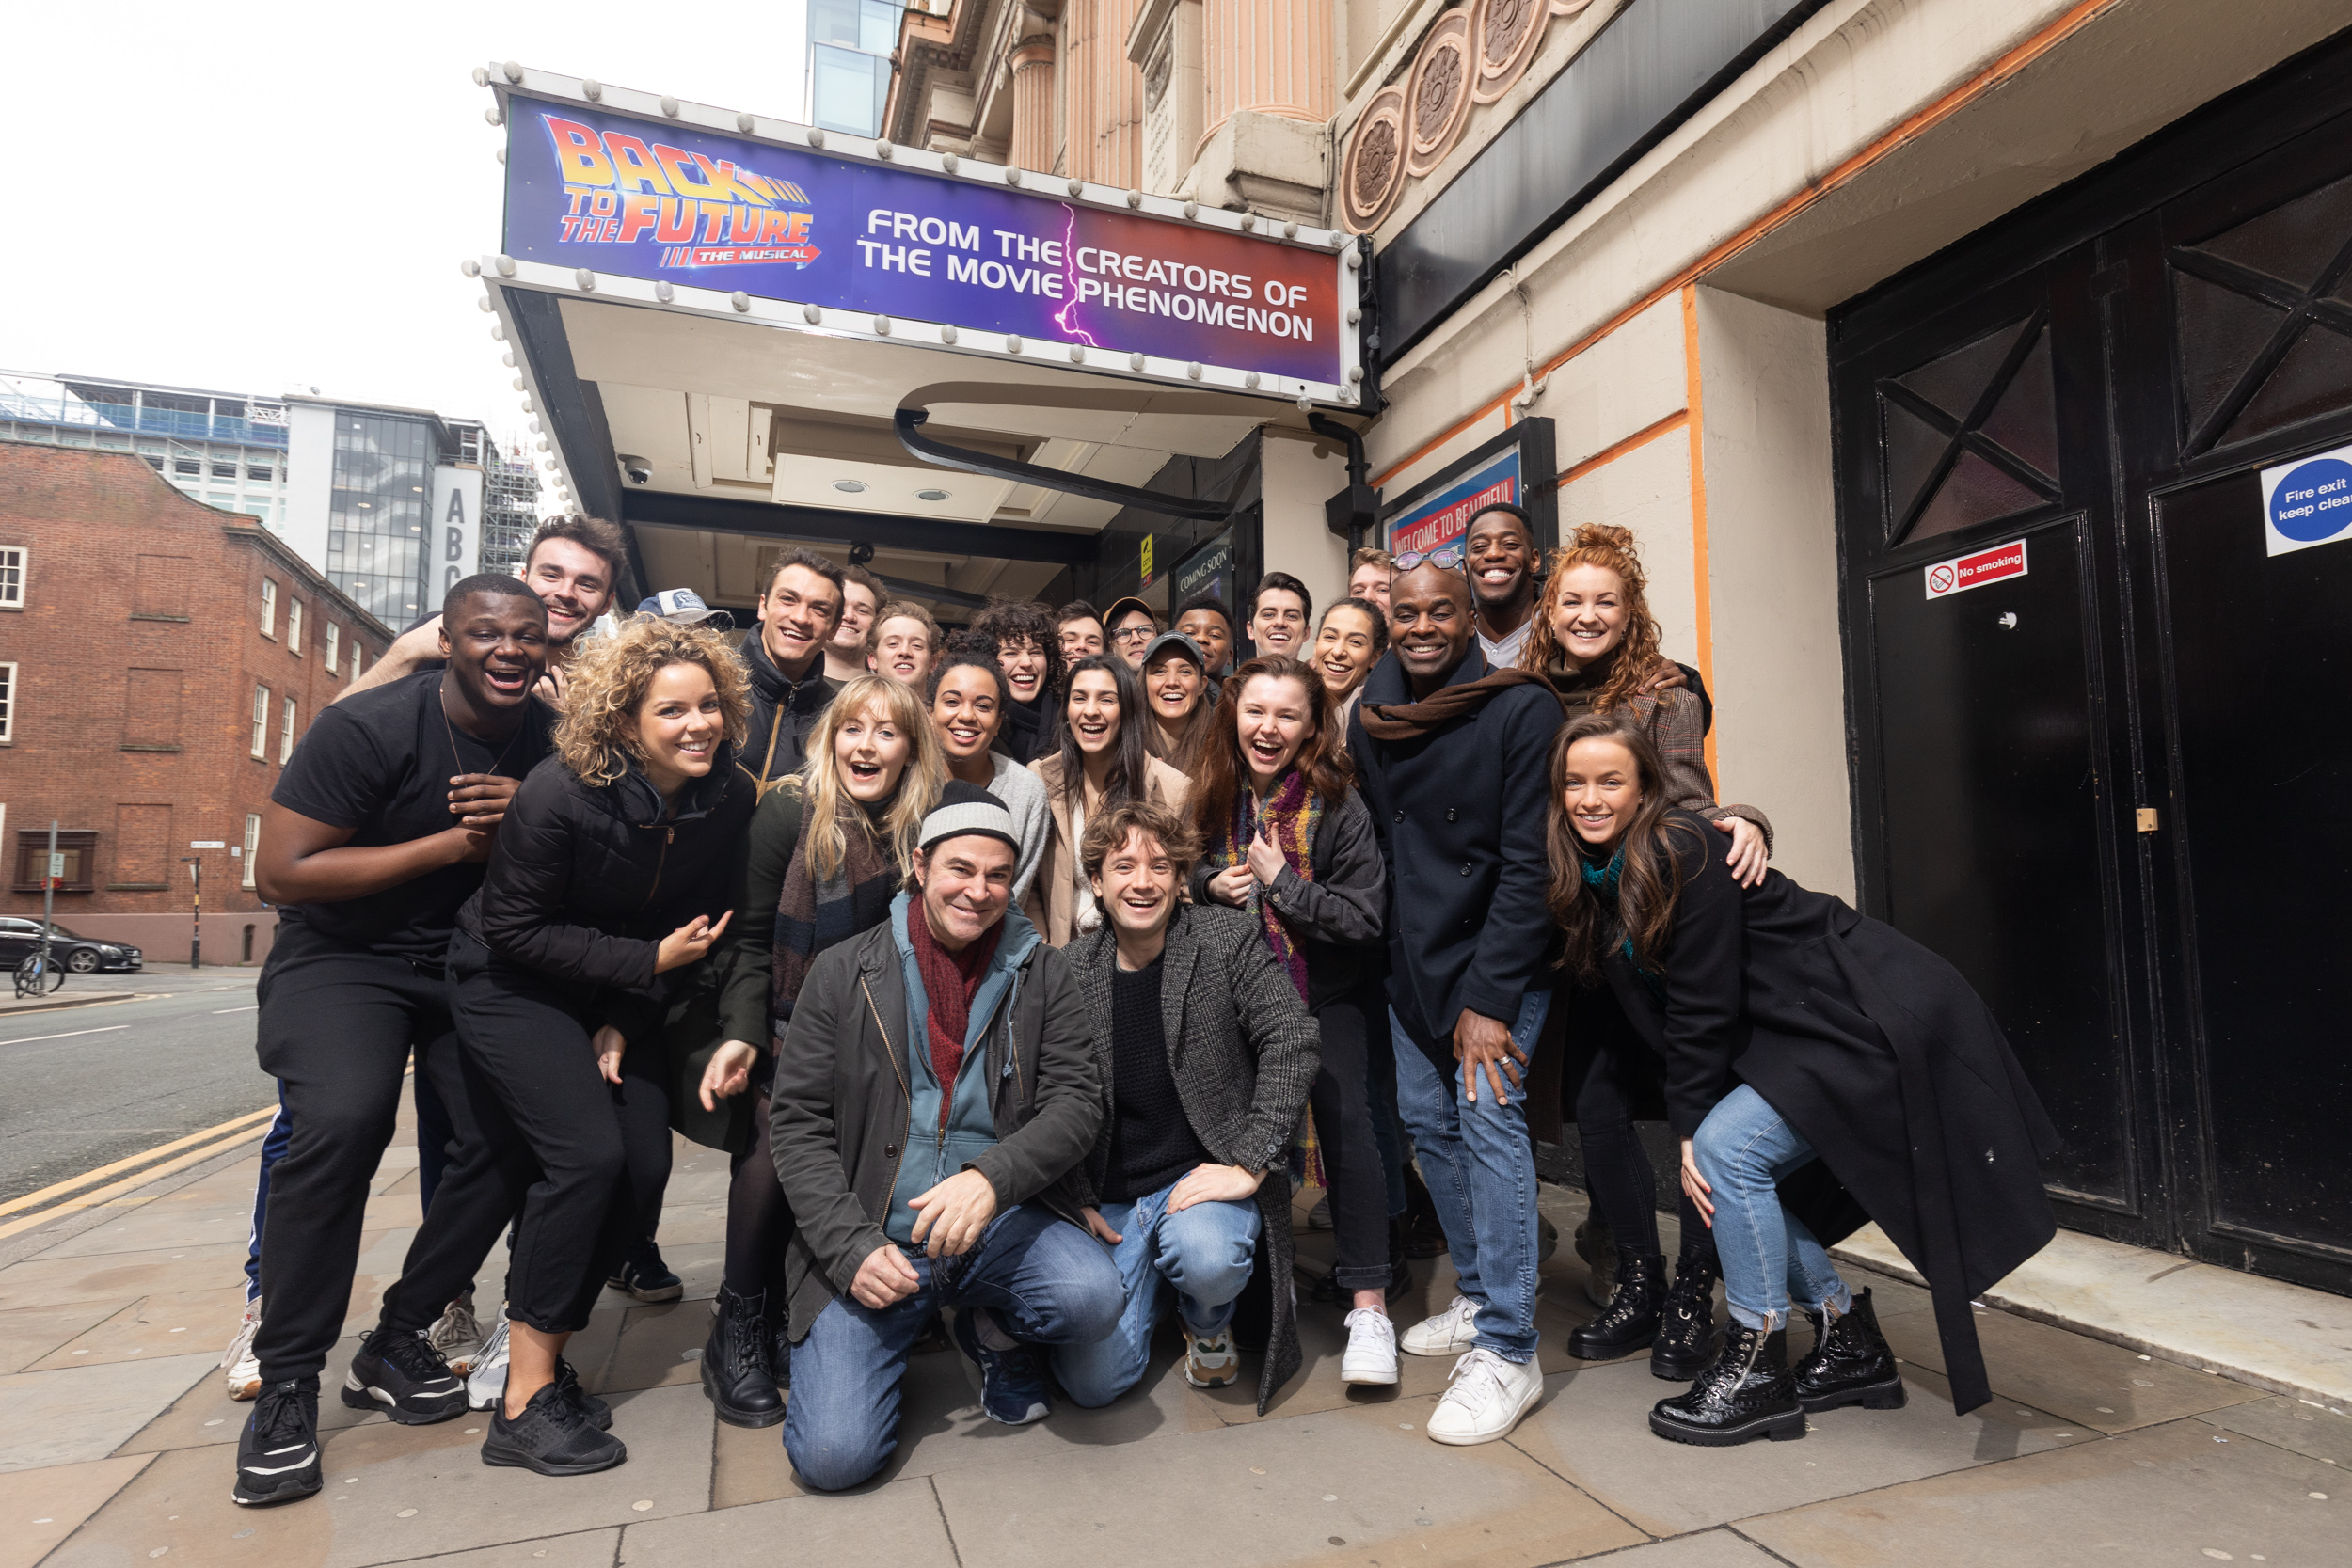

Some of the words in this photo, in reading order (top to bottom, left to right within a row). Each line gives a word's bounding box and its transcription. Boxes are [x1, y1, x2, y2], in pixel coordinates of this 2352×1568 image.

[542, 114, 774, 207] BACK
[559, 215, 619, 243] THE
[615, 194, 814, 244] FUTURE
[564, 185, 618, 217] TO
[699, 250, 735, 262] THE
[739, 249, 809, 261] MUSICAL
[868, 208, 980, 252] FROM
[993, 230, 1063, 267] THE
[1075, 246, 1253, 300] CREATORS
[1263, 280, 1307, 309] OF
[856, 239, 931, 277] THE
[947, 254, 1063, 299] MOVIE
[1078, 277, 1313, 341] PHENOMENON
[2279, 504, 2314, 521] keep
[2285, 488, 2314, 504] Fire
[2318, 478, 2347, 495] exit
[1394, 519, 1438, 556] WELCOME
[1439, 512, 1454, 538] TO
[1180, 562, 1207, 592] COMING
[1207, 546, 1227, 573] SOON
[1959, 567, 1974, 578] No
[1976, 554, 2022, 574] smoking
